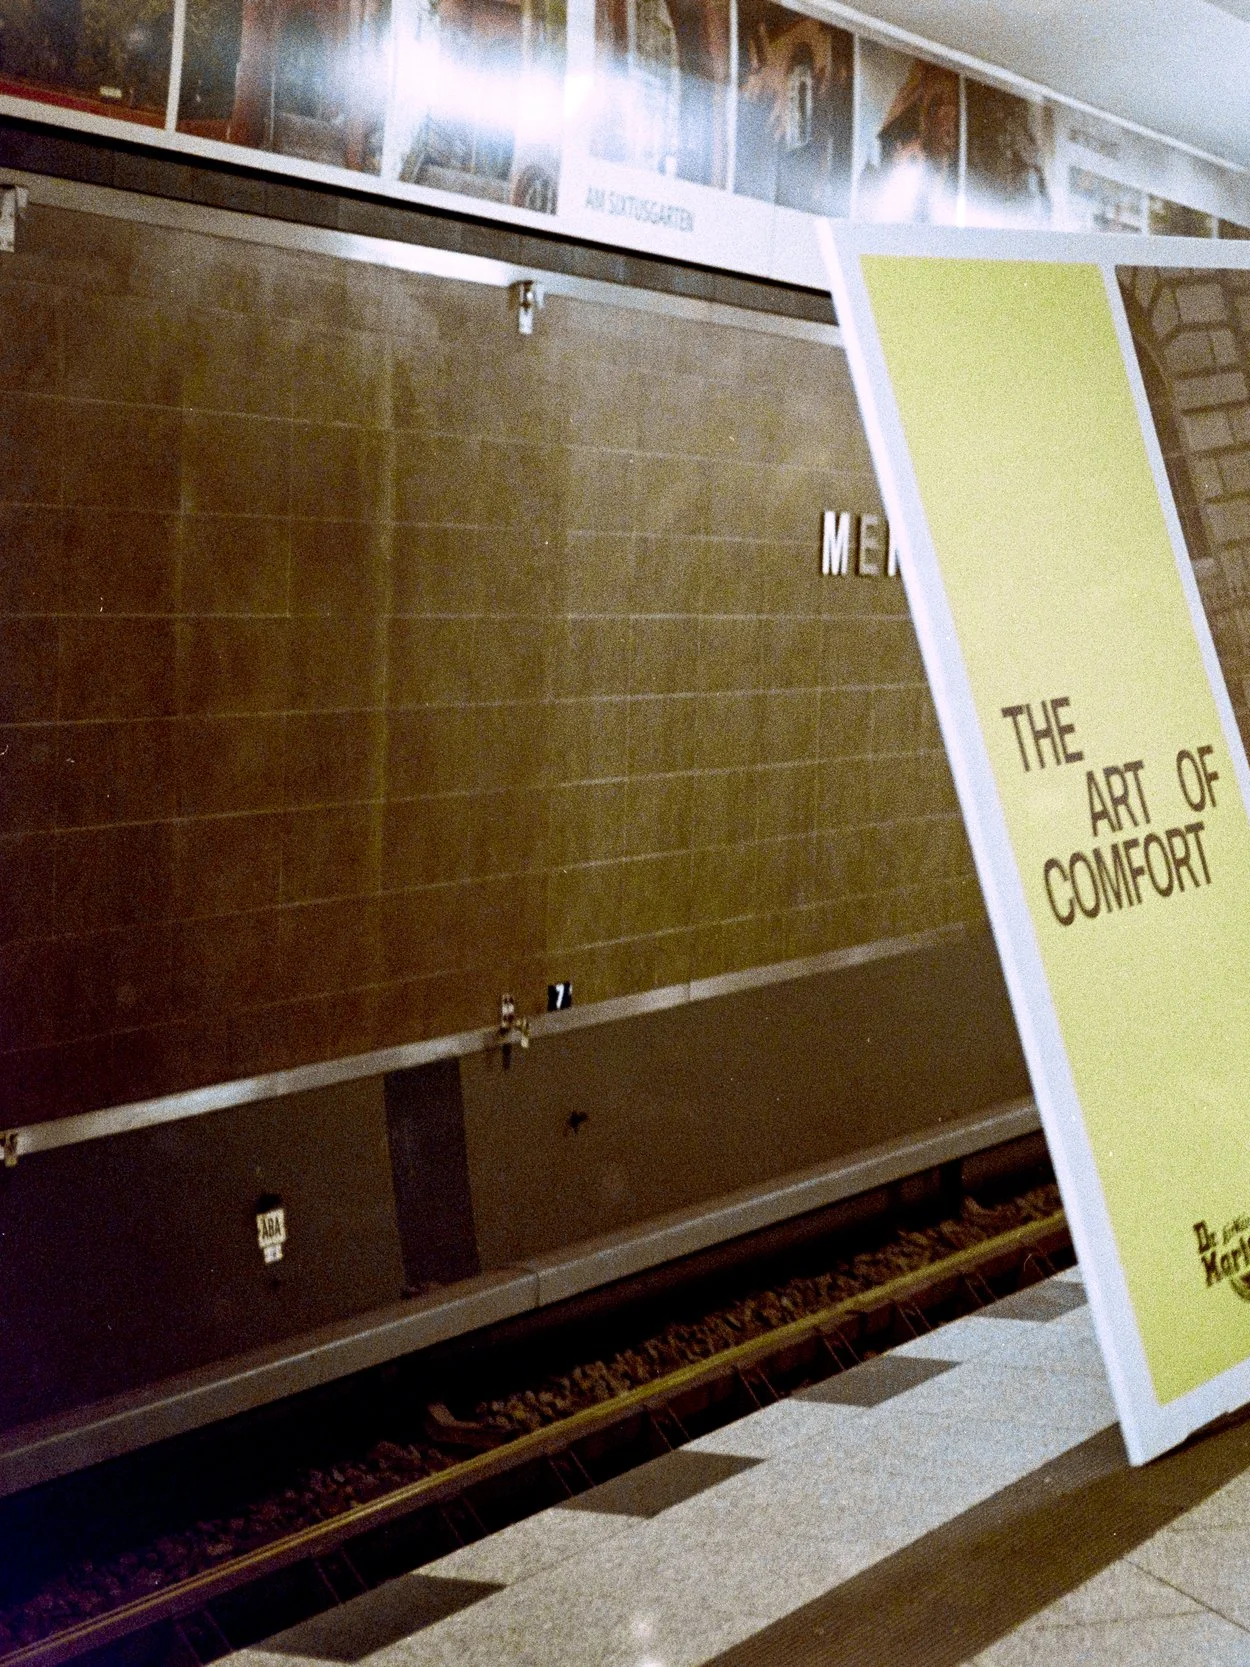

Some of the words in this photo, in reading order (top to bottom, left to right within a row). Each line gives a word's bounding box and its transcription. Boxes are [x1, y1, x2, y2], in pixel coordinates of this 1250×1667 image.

[1001, 696, 1084, 772] THE
[1086, 759, 1151, 837] ART
[1176, 744, 1219, 812] OF
[1043, 820, 1212, 927] COMFORT
